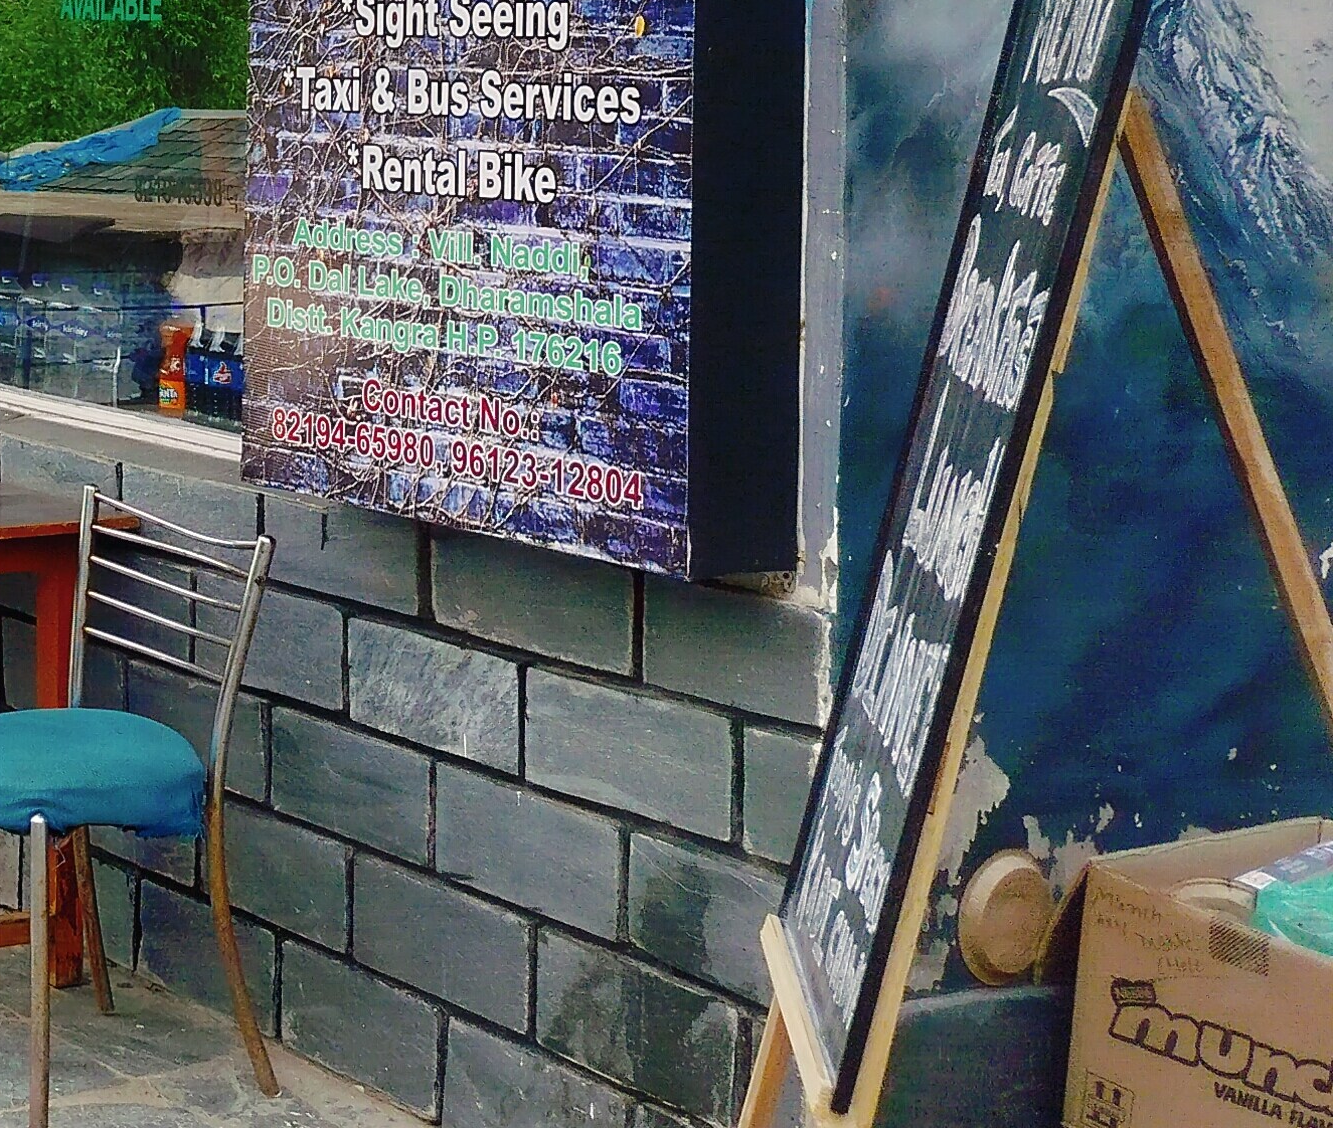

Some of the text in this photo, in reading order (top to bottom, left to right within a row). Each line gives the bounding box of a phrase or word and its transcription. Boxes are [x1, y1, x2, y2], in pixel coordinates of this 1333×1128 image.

[371, 67, 396, 115] &
[407, 68, 470, 118] Bus
[479, 69, 641, 125] Services
[478, 149, 557, 204] Bike
[292, 218, 404, 258] Address
[428, 228, 483, 266] Vill.
[490, 236, 591, 283] Naddi,
[252, 254, 642, 332] P.O. Dal Lake, Dharamshala
[266, 298, 623, 376] Distt. Kangra H.P. 176216
[362, 378, 470, 429] Contact
[452, 442, 644, 510] 96123-12804
[1214, 1082, 1282, 1120] VANILLA
